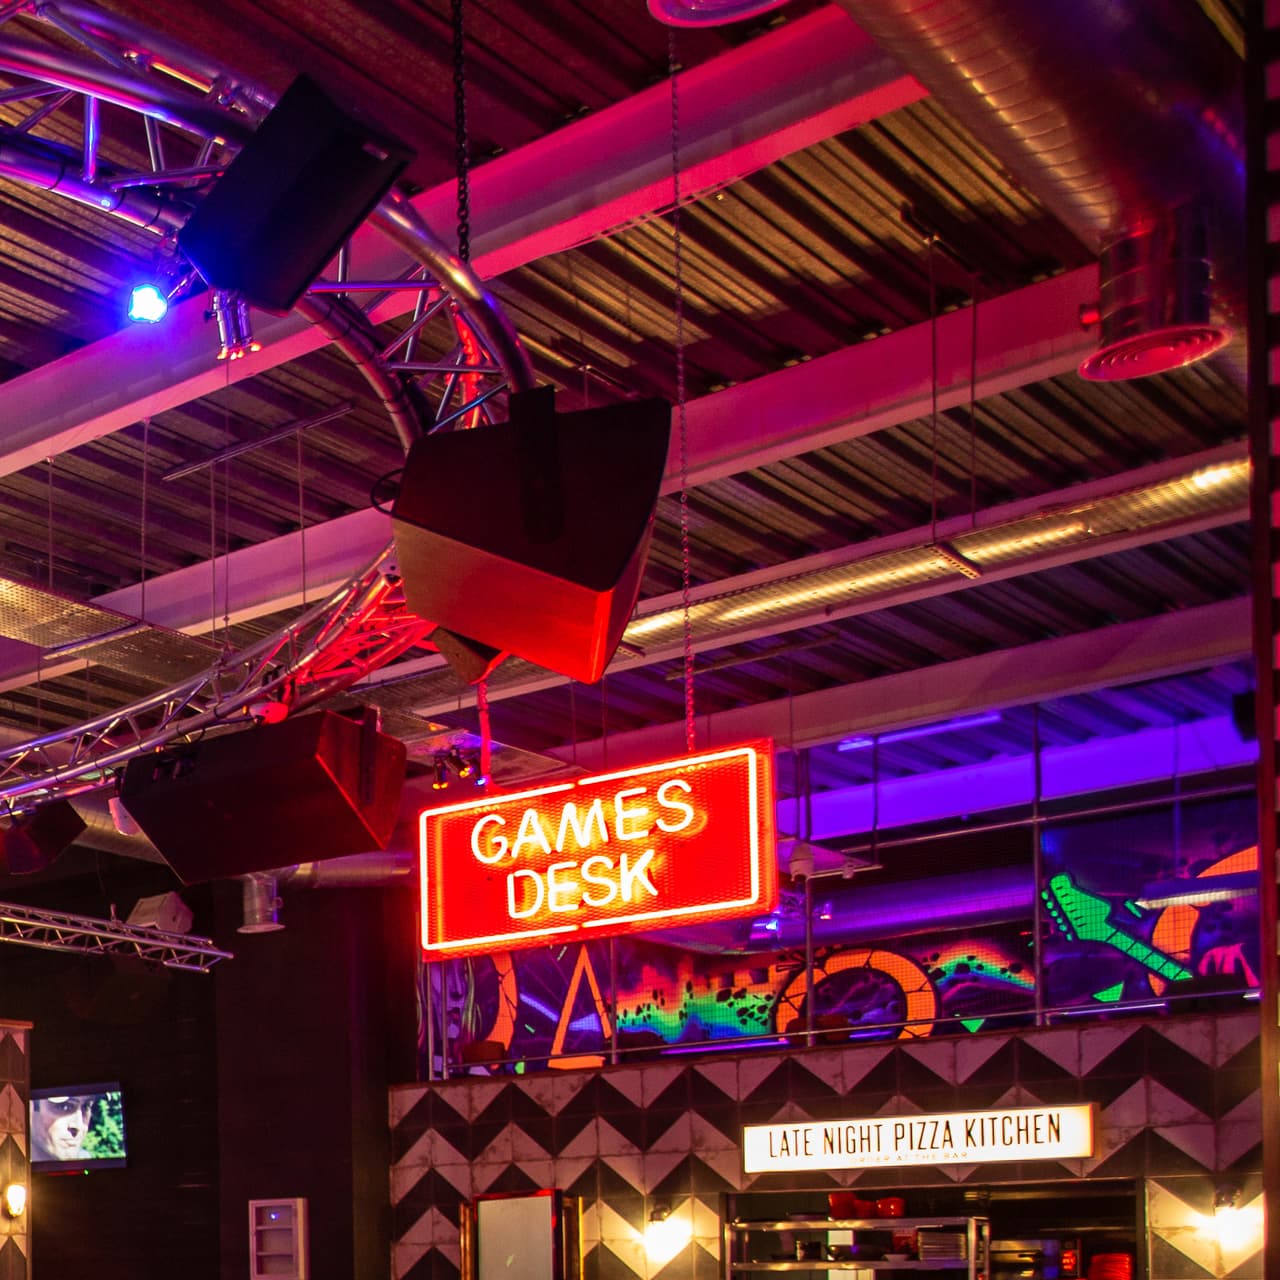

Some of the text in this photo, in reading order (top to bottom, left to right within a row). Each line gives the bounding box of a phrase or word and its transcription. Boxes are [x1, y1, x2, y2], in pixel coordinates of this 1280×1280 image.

[470, 778, 695, 865] GAMES
[506, 848, 659, 920] DESK
[768, 1112, 1062, 1158] LATE NIGHT PIZZA KITCHEN
